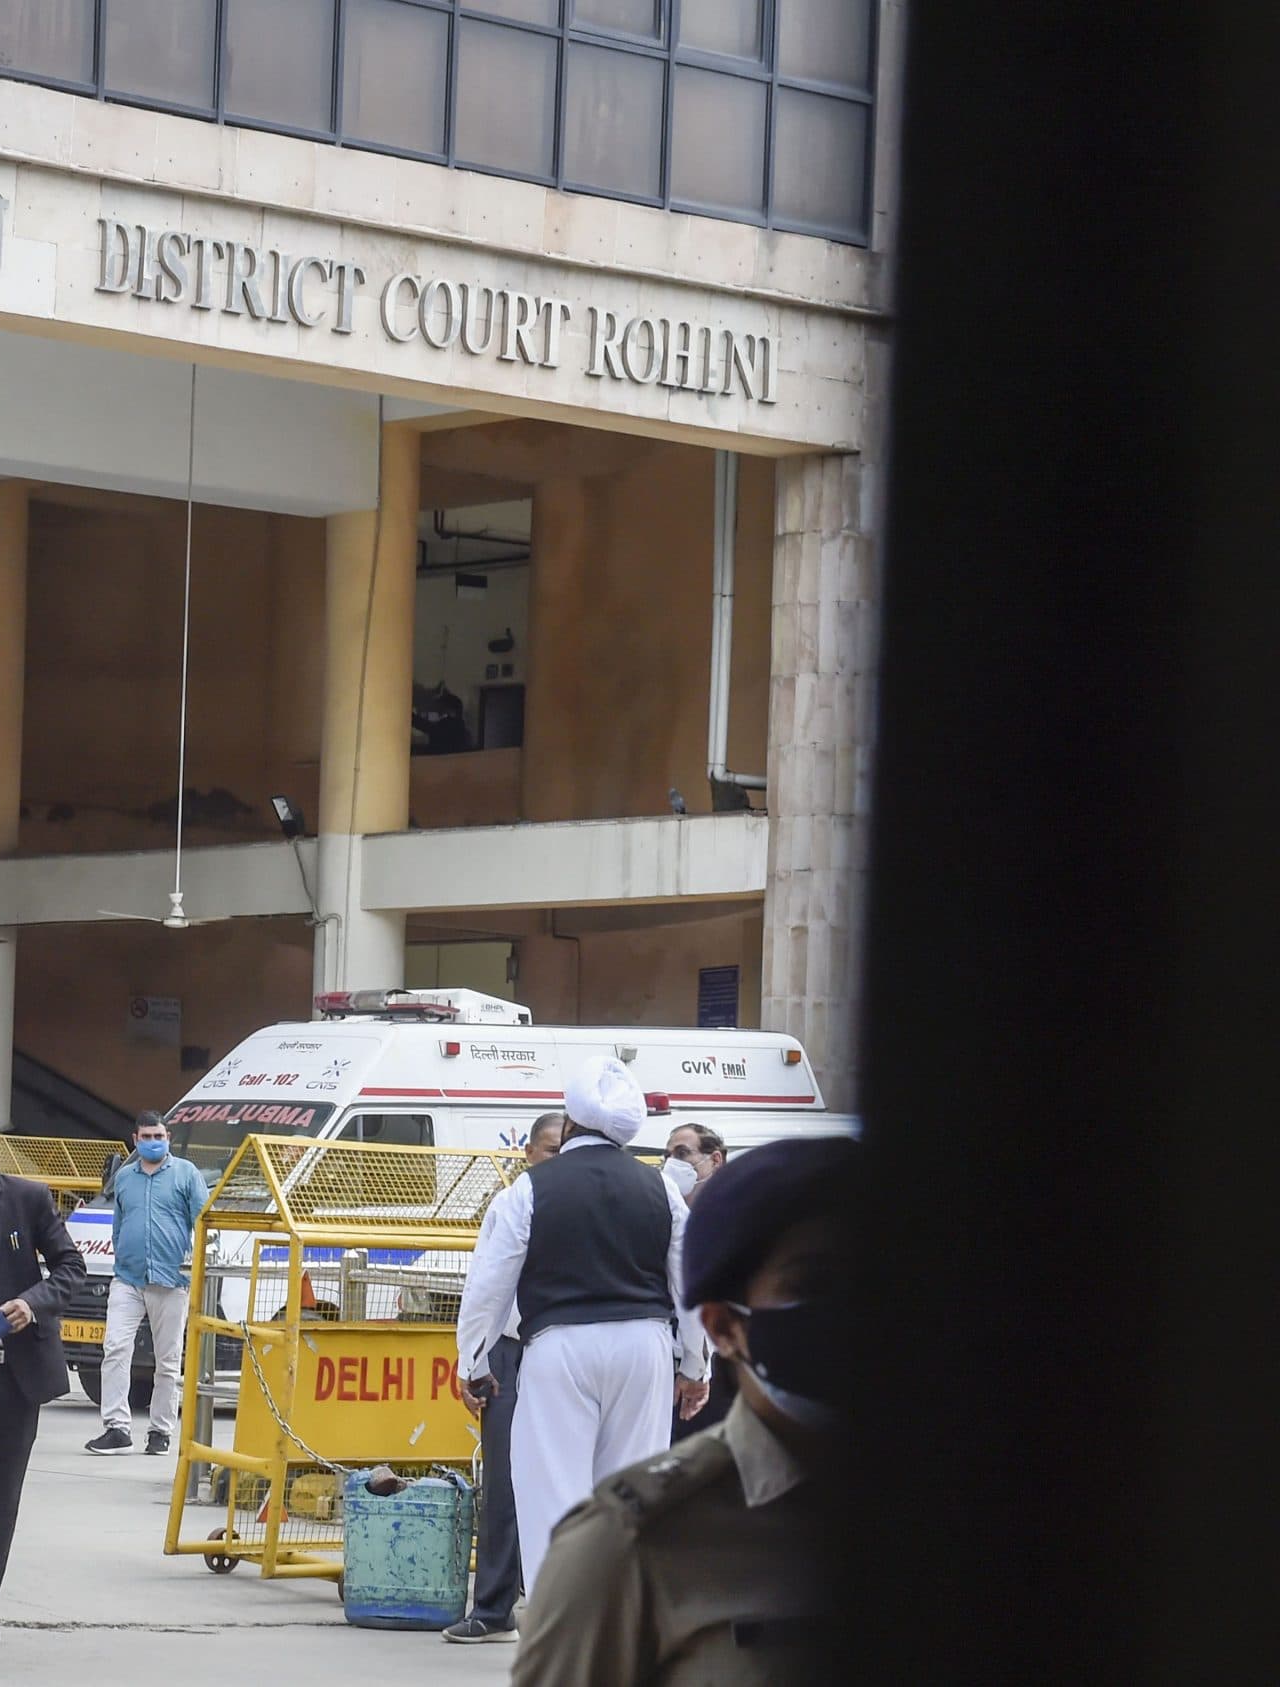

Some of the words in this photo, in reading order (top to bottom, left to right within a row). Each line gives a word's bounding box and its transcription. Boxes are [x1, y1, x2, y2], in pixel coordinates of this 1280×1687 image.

[96, 218, 366, 334] DISTRICT
[381, 273, 571, 368] COURT
[585, 306, 780, 404] ROHINI
[470, 1044, 499, 1061] दिल्ली
[500, 1050, 536, 1062] सरकार
[681, 1060, 713, 1075] GVK
[89, 1326, 105, 1340] 297
[314, 1356, 415, 1402] DELHI
